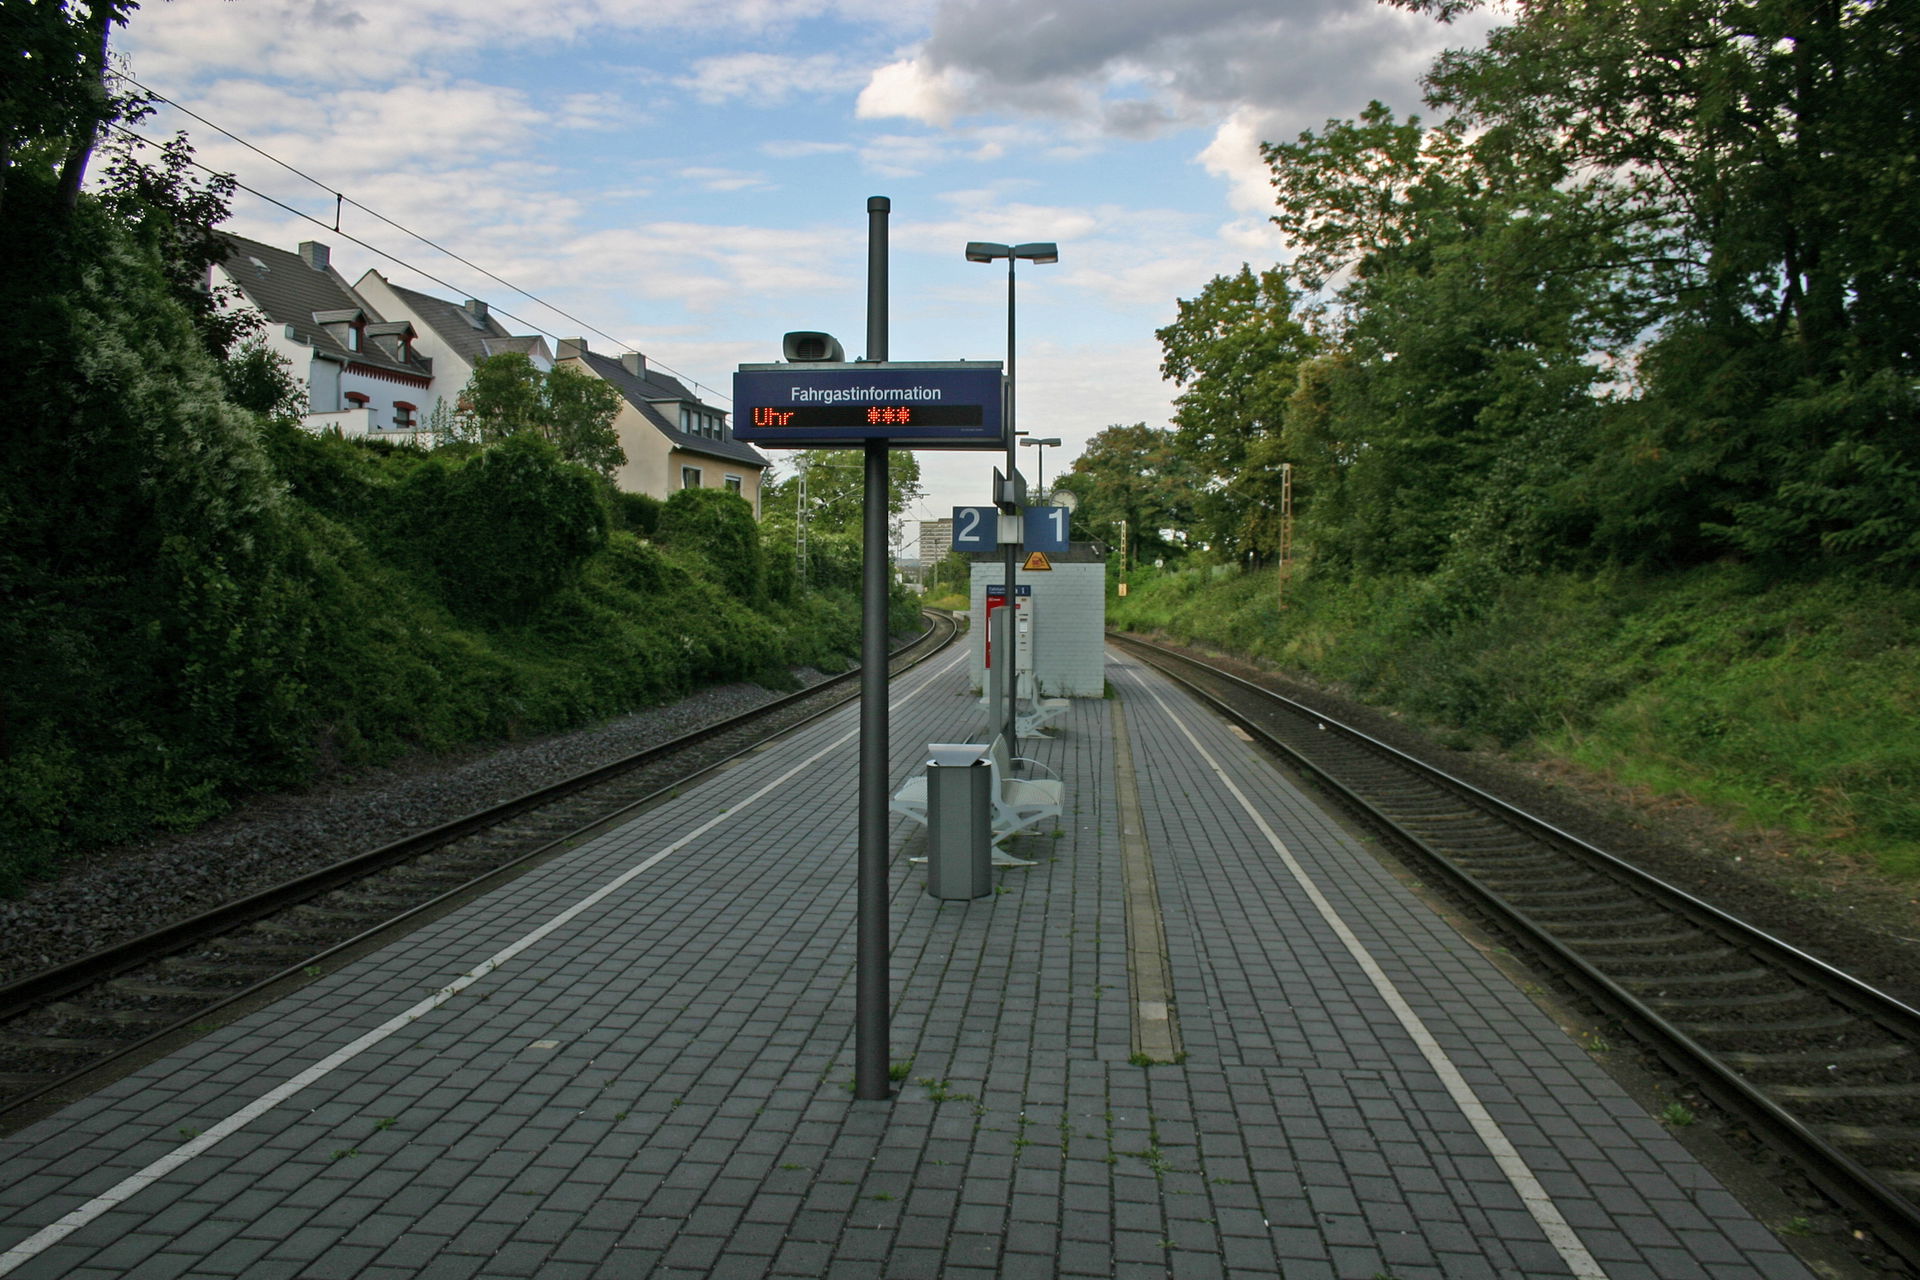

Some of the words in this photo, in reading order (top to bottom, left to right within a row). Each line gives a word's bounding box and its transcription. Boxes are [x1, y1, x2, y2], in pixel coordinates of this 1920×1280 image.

[791, 386, 942, 404] Fahrgastinformation
[754, 407, 794, 426] Uhr
[958, 507, 980, 542] 2
[1048, 508, 1063, 542] 1
